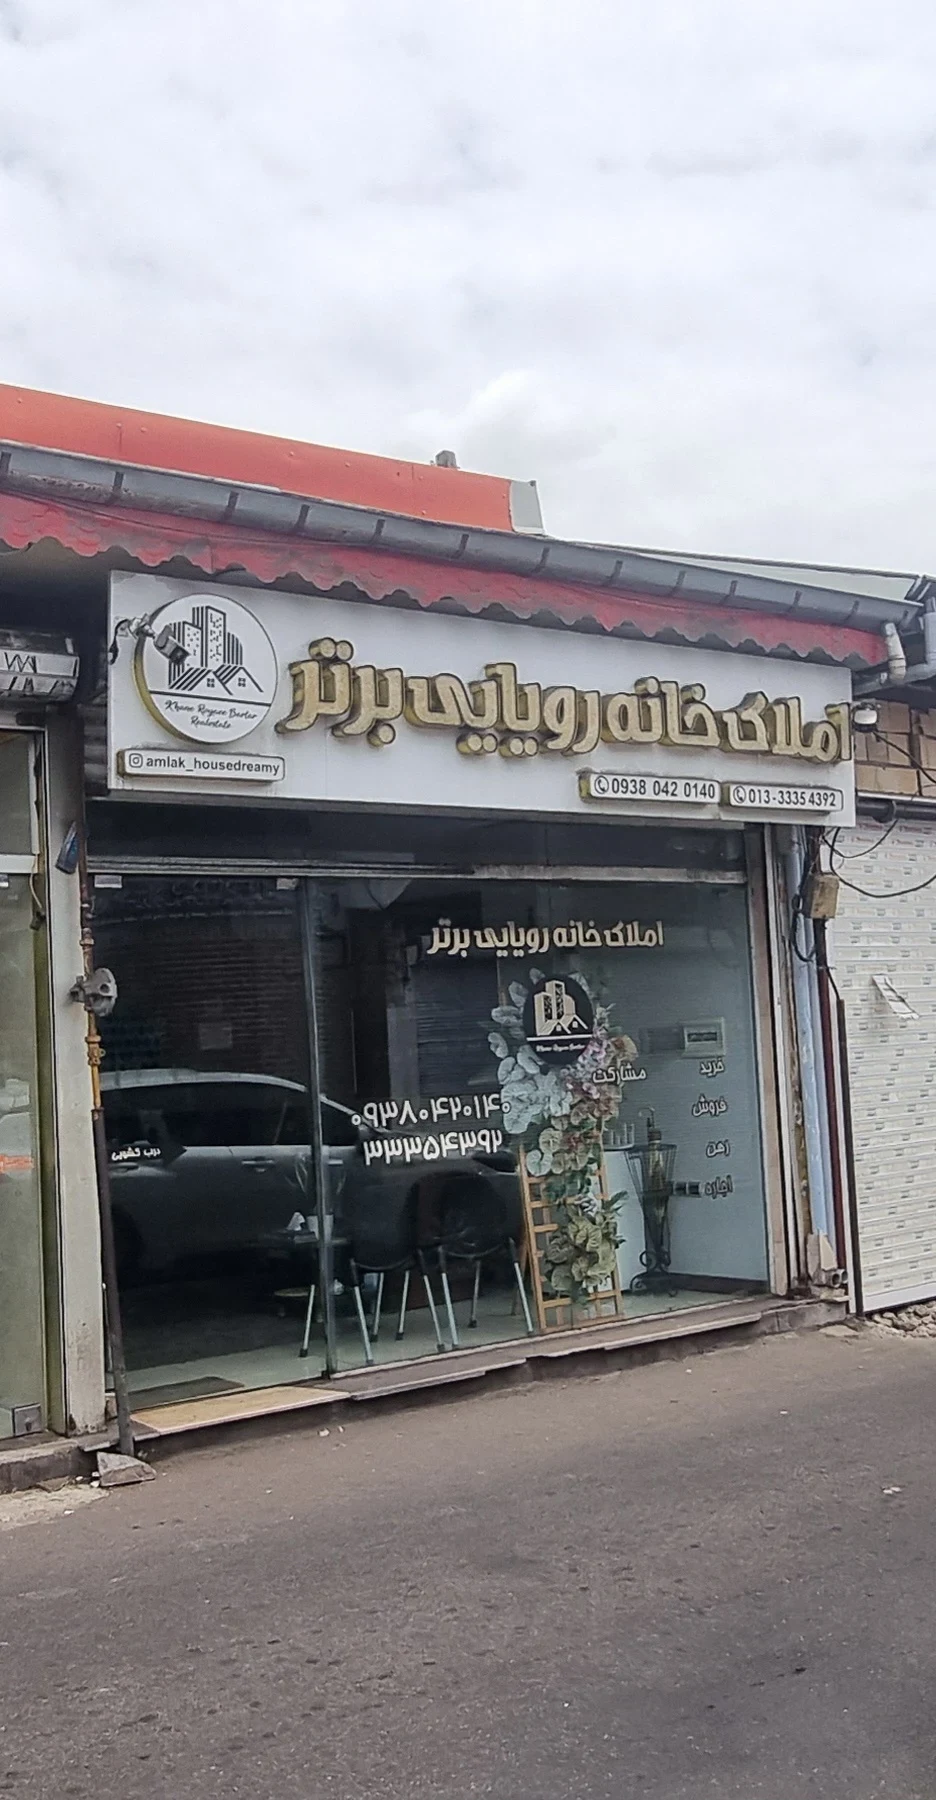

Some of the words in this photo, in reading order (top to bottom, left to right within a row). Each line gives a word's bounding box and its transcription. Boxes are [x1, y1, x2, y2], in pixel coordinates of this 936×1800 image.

[276, 637, 403, 747] برتر
[404, 662, 600, 756] رویایی
[604, 676, 721, 746] خانه
[723, 690, 851, 763] املاک
[146, 755, 280, 776] amlak_housedreamy
[611, 778, 647, 796] 0938
[652, 780, 678, 797] 042
[683, 782, 716, 799] 0140
[427, 917, 471, 958] برتر
[476, 920, 550, 958] رویایی
[552, 919, 602, 947] خانه
[605, 919, 664, 947] املاک
[592, 1063, 647, 1084] مشارکت
[700, 1058, 725, 1077] خرید
[351, 1094, 511, 1128] ۰۹۳۸۰۴۲۰۱۴۰
[692, 1094, 728, 1117] فروش
[143, 1147, 161, 1158] درب
[363, 1129, 502, 1166] ۳۳۳۵۴۳۹۲
[706, 1140, 730, 1158] رهن
[704, 1175, 733, 1199] اجاره
